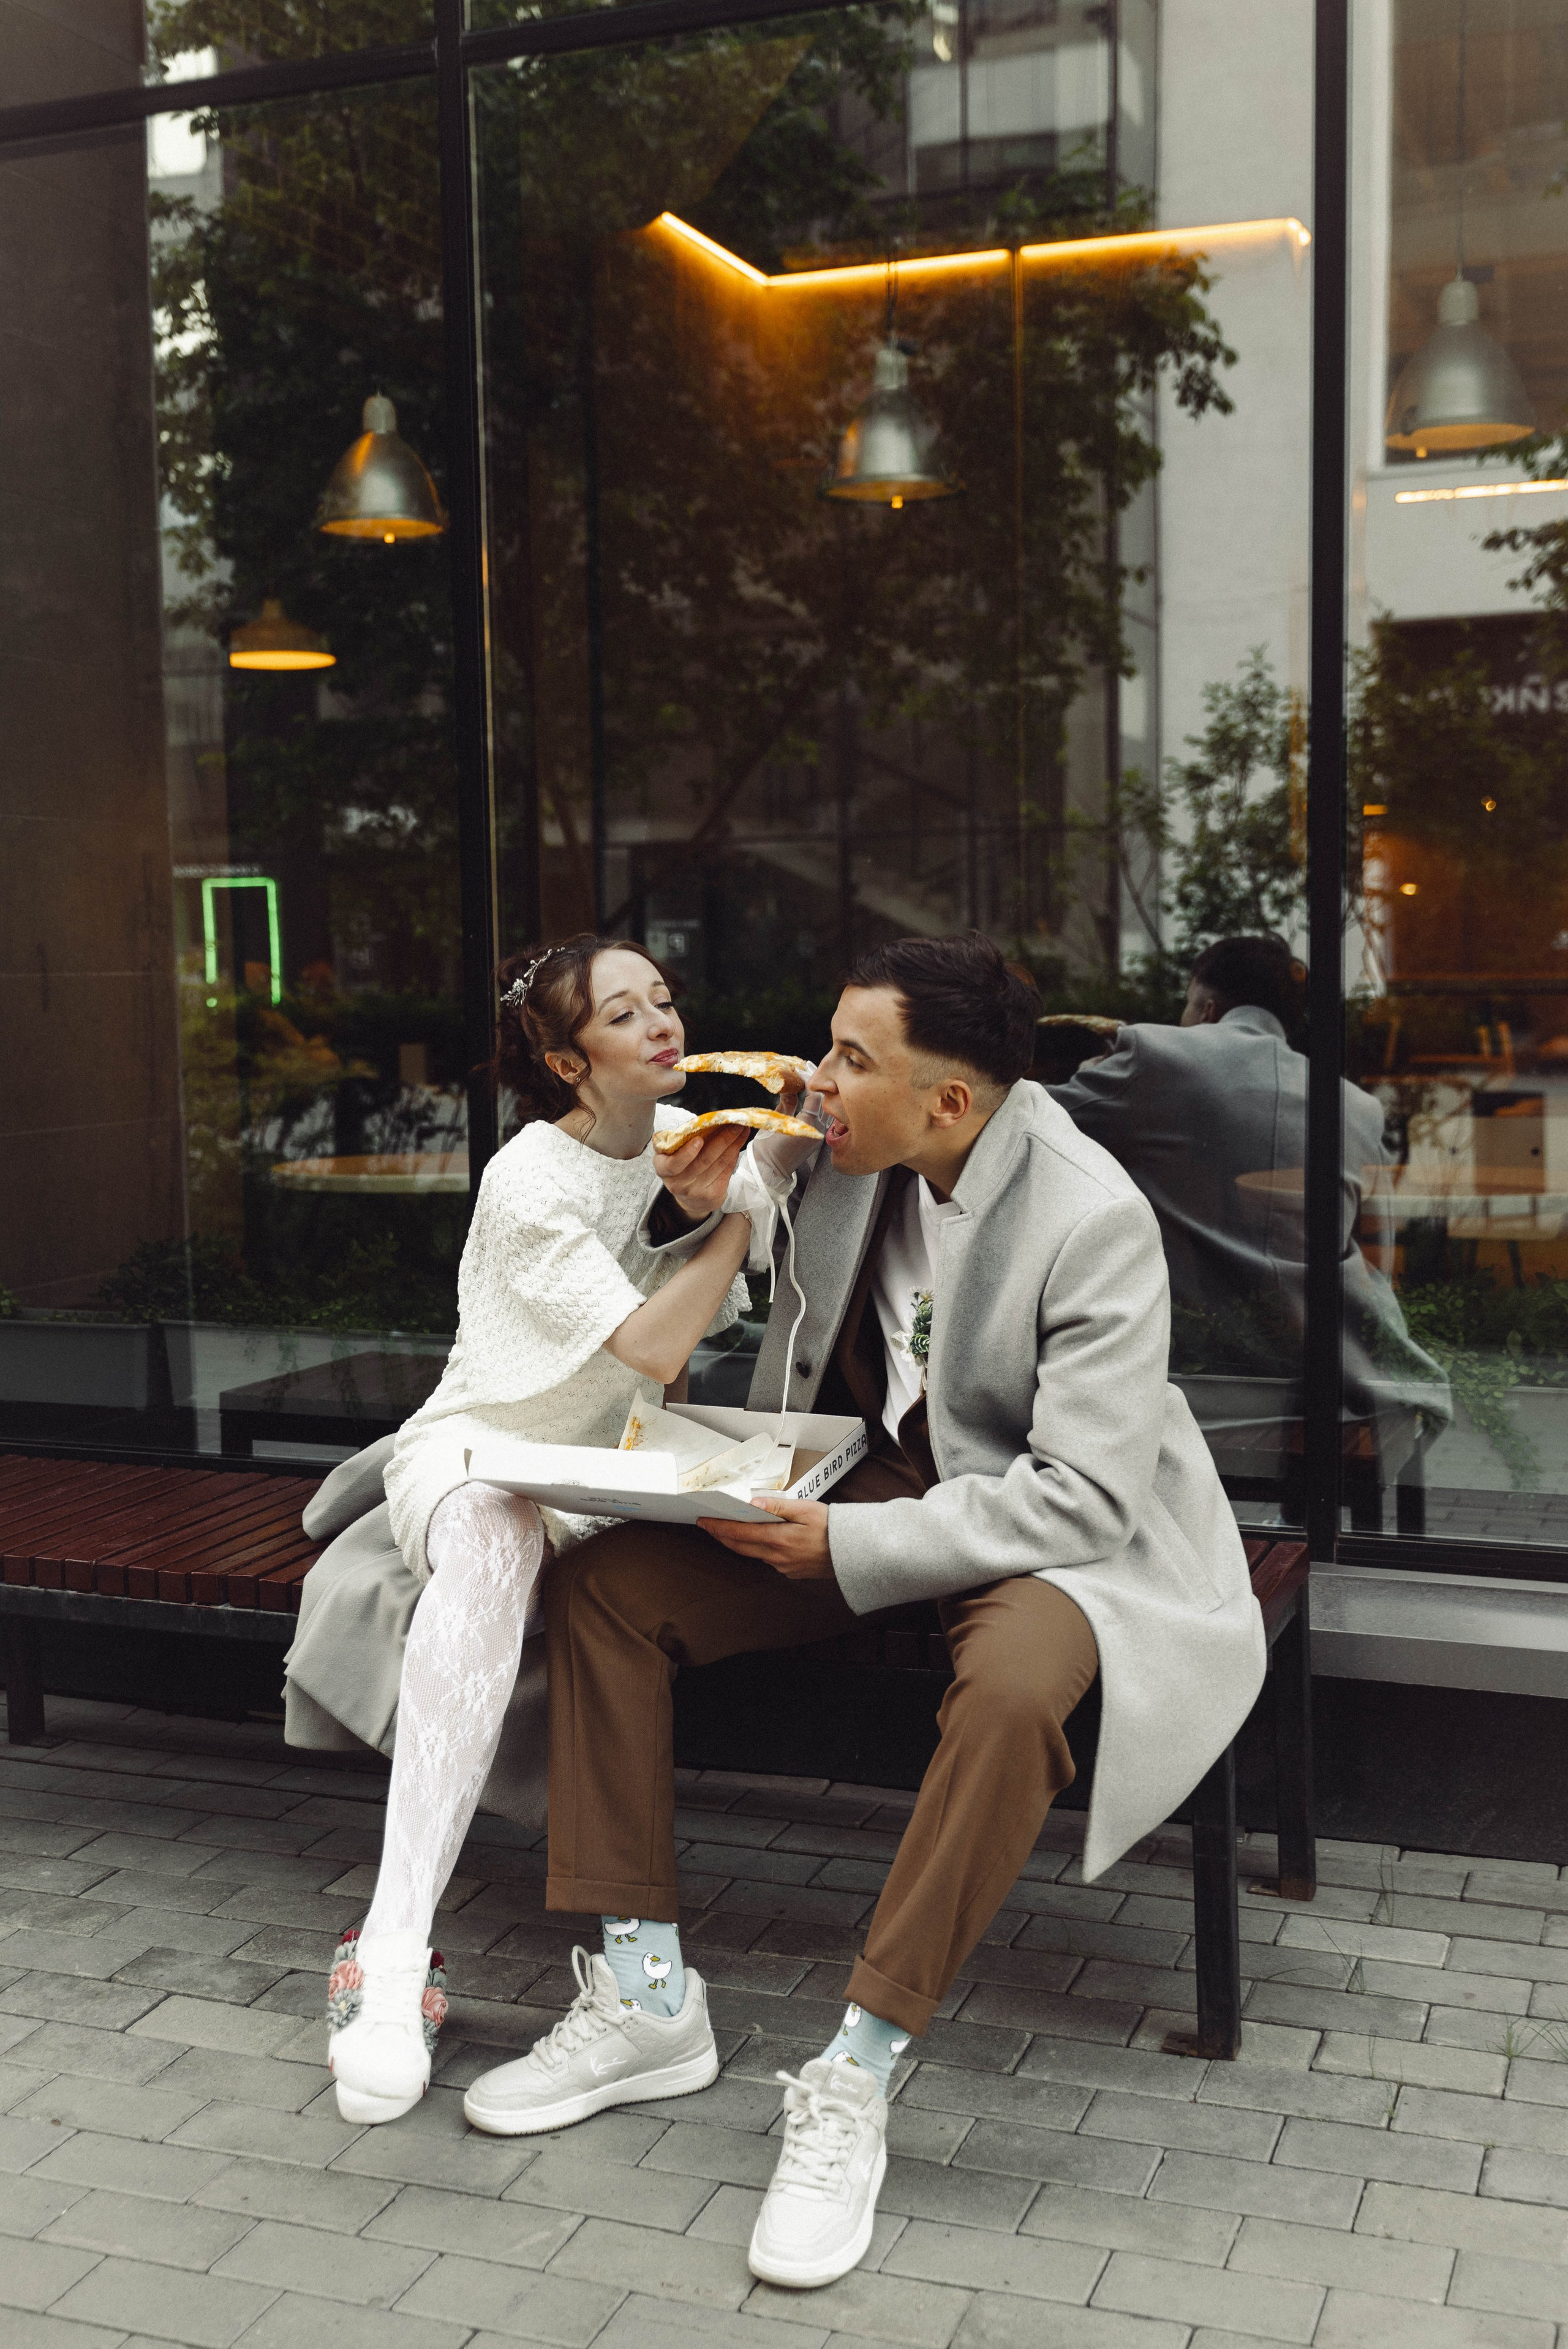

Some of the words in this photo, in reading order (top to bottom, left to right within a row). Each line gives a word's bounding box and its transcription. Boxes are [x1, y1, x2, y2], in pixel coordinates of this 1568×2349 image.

[797, 1474, 821, 1499] BLUE
[823, 1455, 843, 1480] BIRD
[845, 1433, 867, 1461] PIZZA
